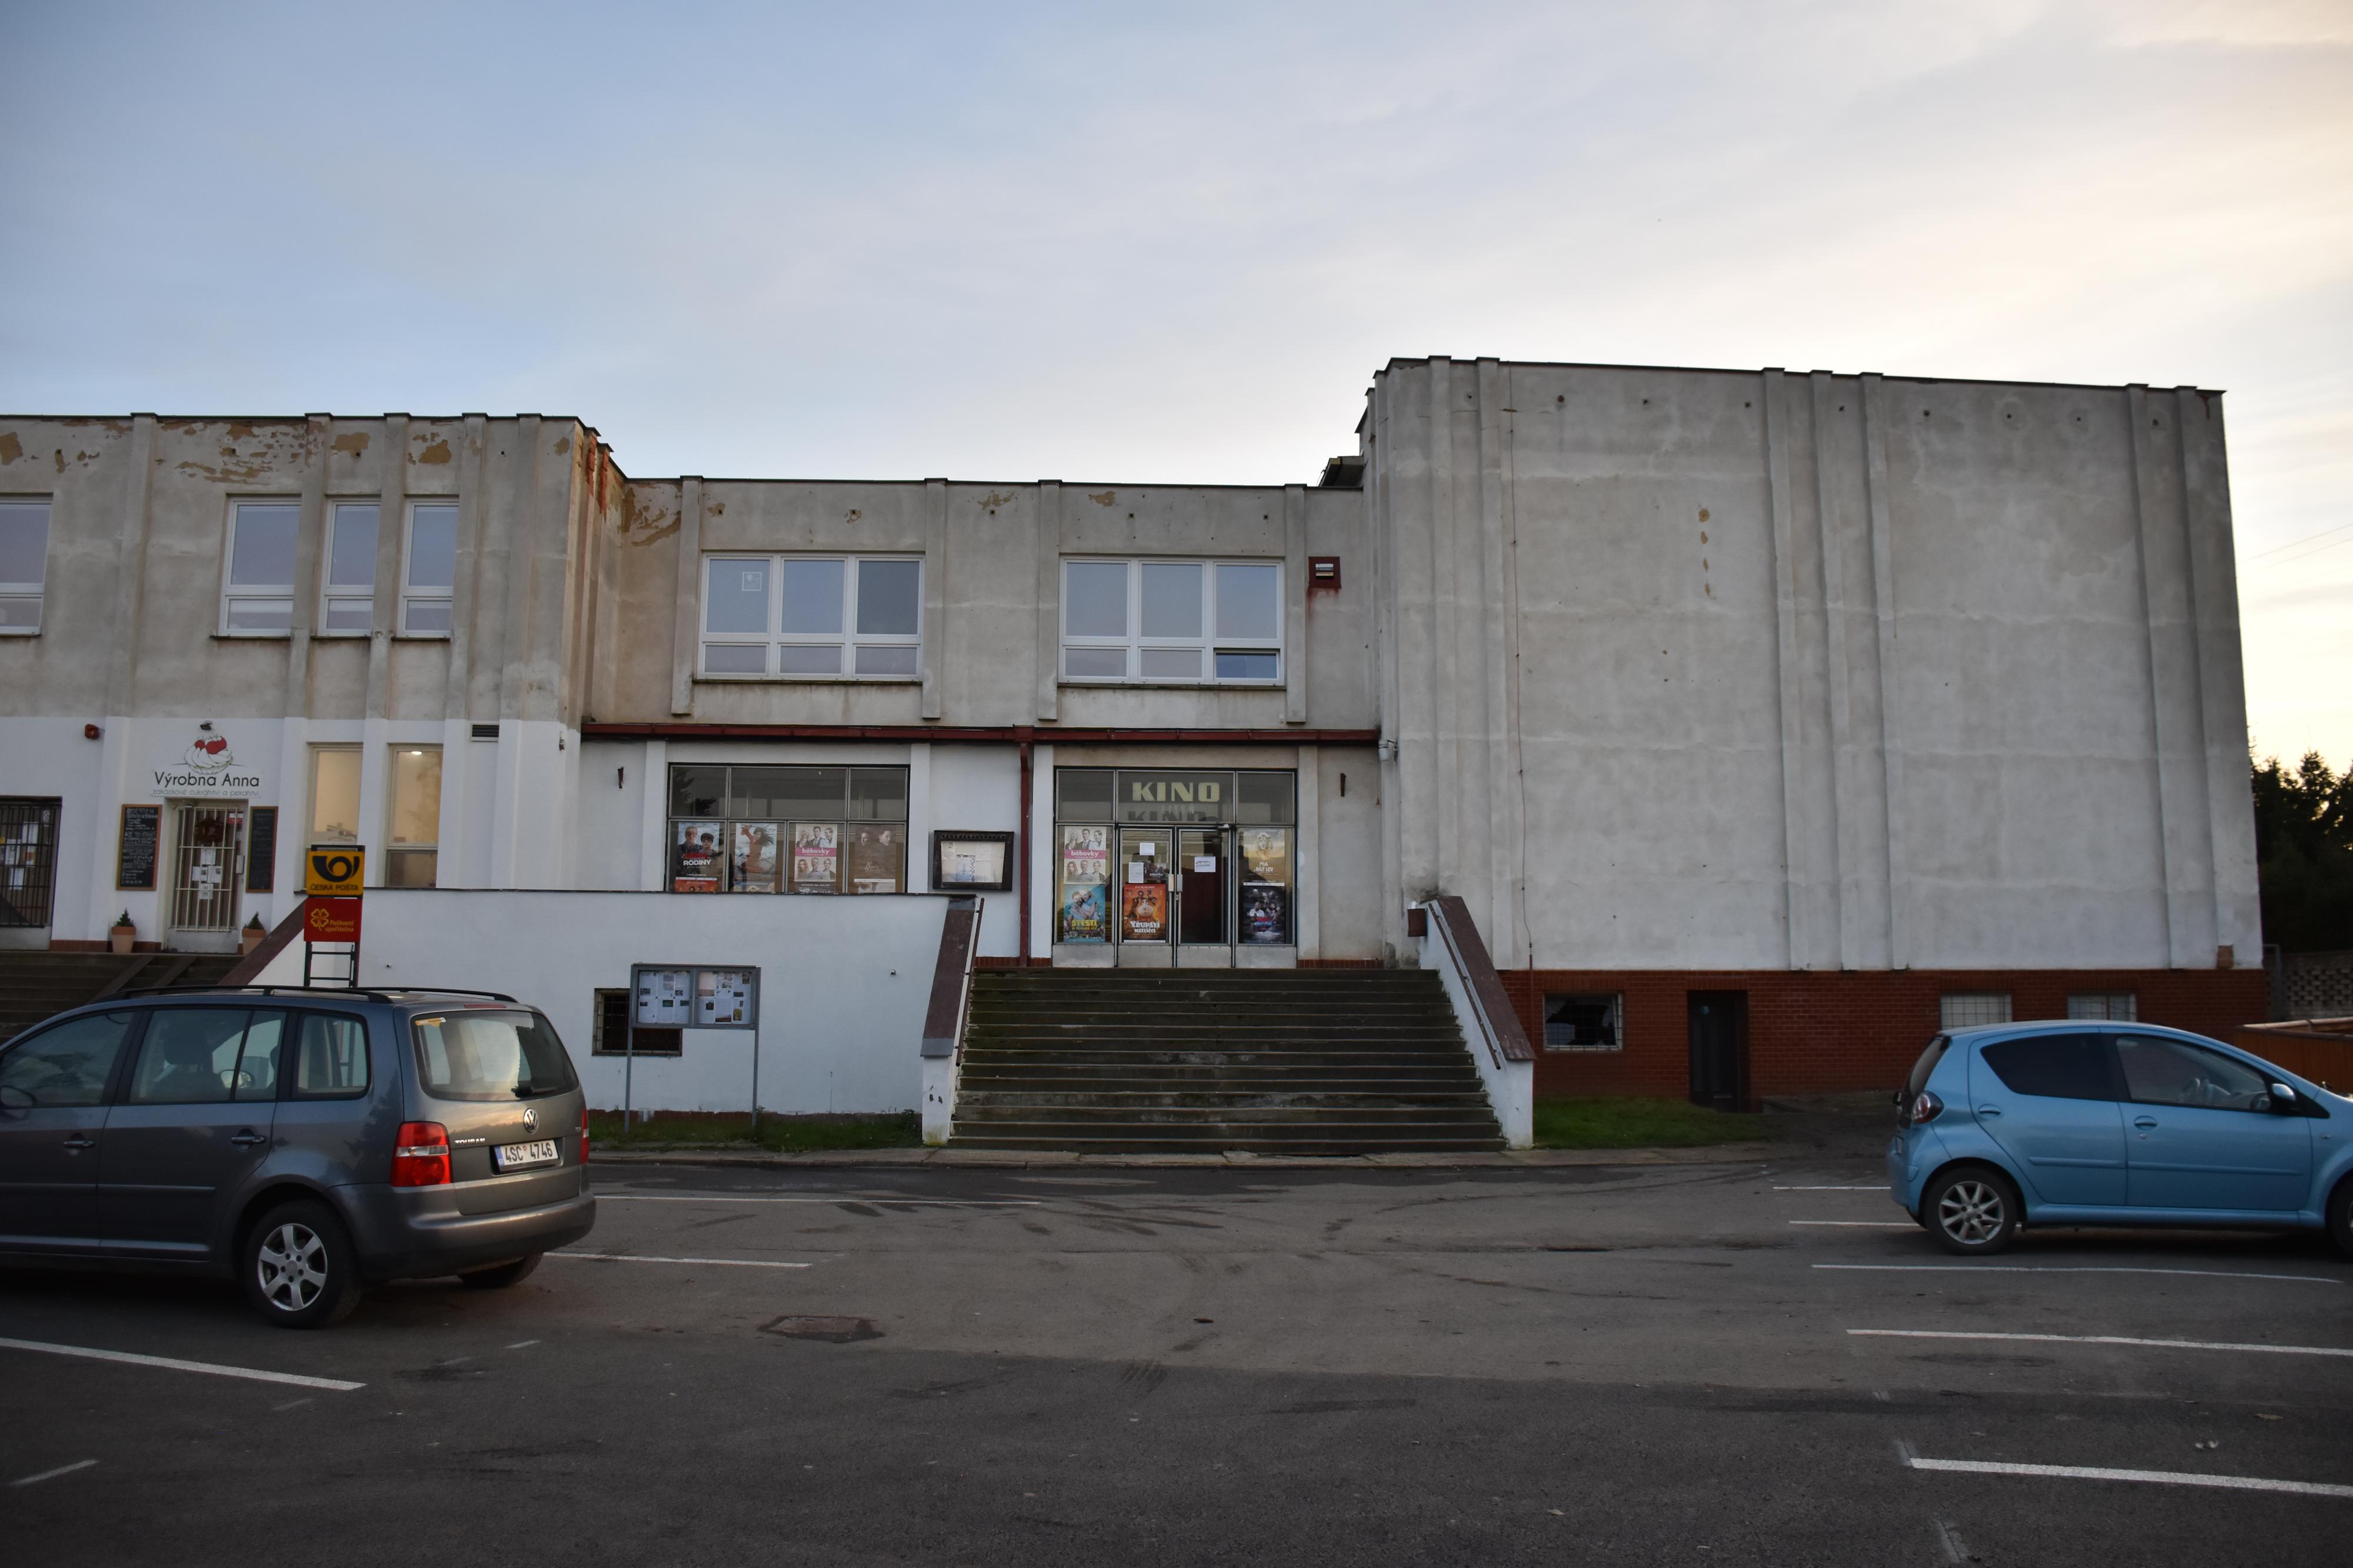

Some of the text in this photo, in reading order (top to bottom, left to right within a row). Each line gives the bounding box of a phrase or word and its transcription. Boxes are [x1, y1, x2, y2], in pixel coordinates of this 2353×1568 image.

[155, 771, 259, 788] Výrobna Anna
[1132, 781, 1220, 802] KINO
[454, 1137, 485, 1146] TOURAN
[505, 1146, 524, 1162] 4SC
[530, 1142, 553, 1159] 4746
